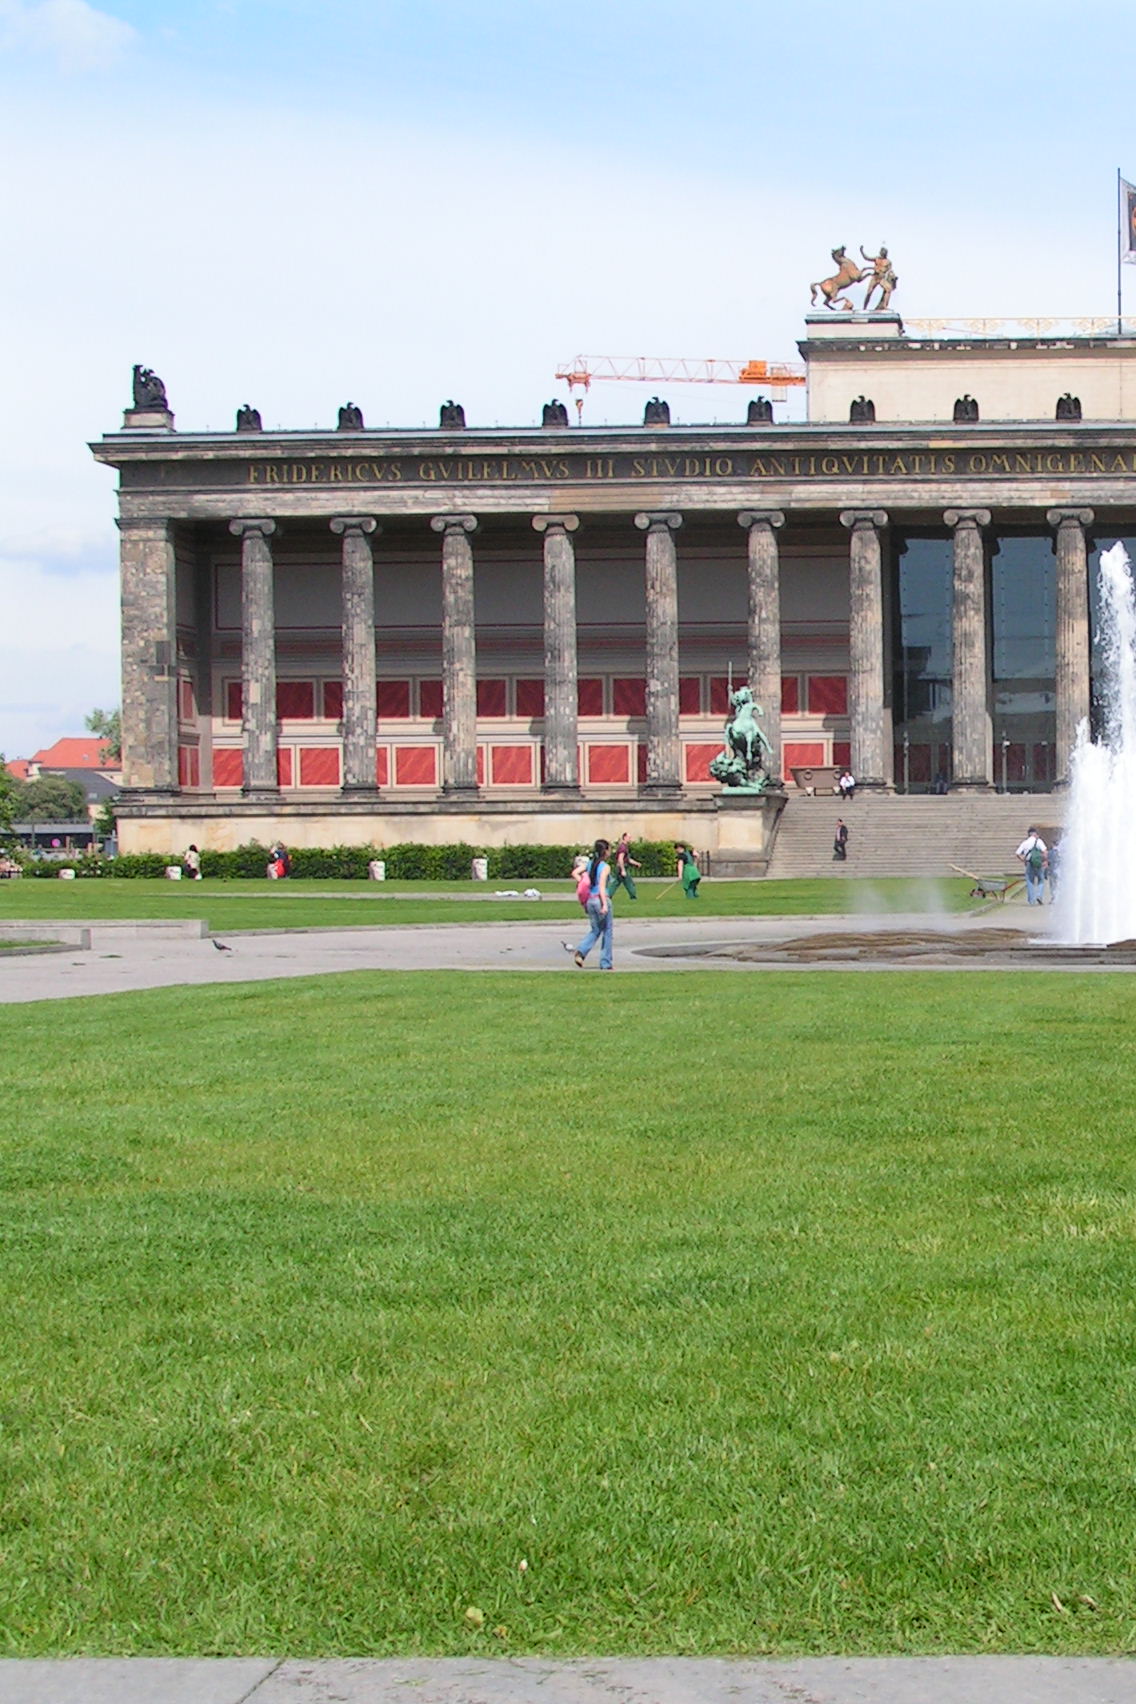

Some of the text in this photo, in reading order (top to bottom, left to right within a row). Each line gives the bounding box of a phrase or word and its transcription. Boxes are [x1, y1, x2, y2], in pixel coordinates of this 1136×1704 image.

[249, 464, 401, 484] FRIDERICVS
[419, 460, 569, 482] GVILELMVS
[585, 459, 614, 480] III
[632, 457, 733, 478] STVDIO
[750, 454, 955, 477] ANTIQVITATIS
